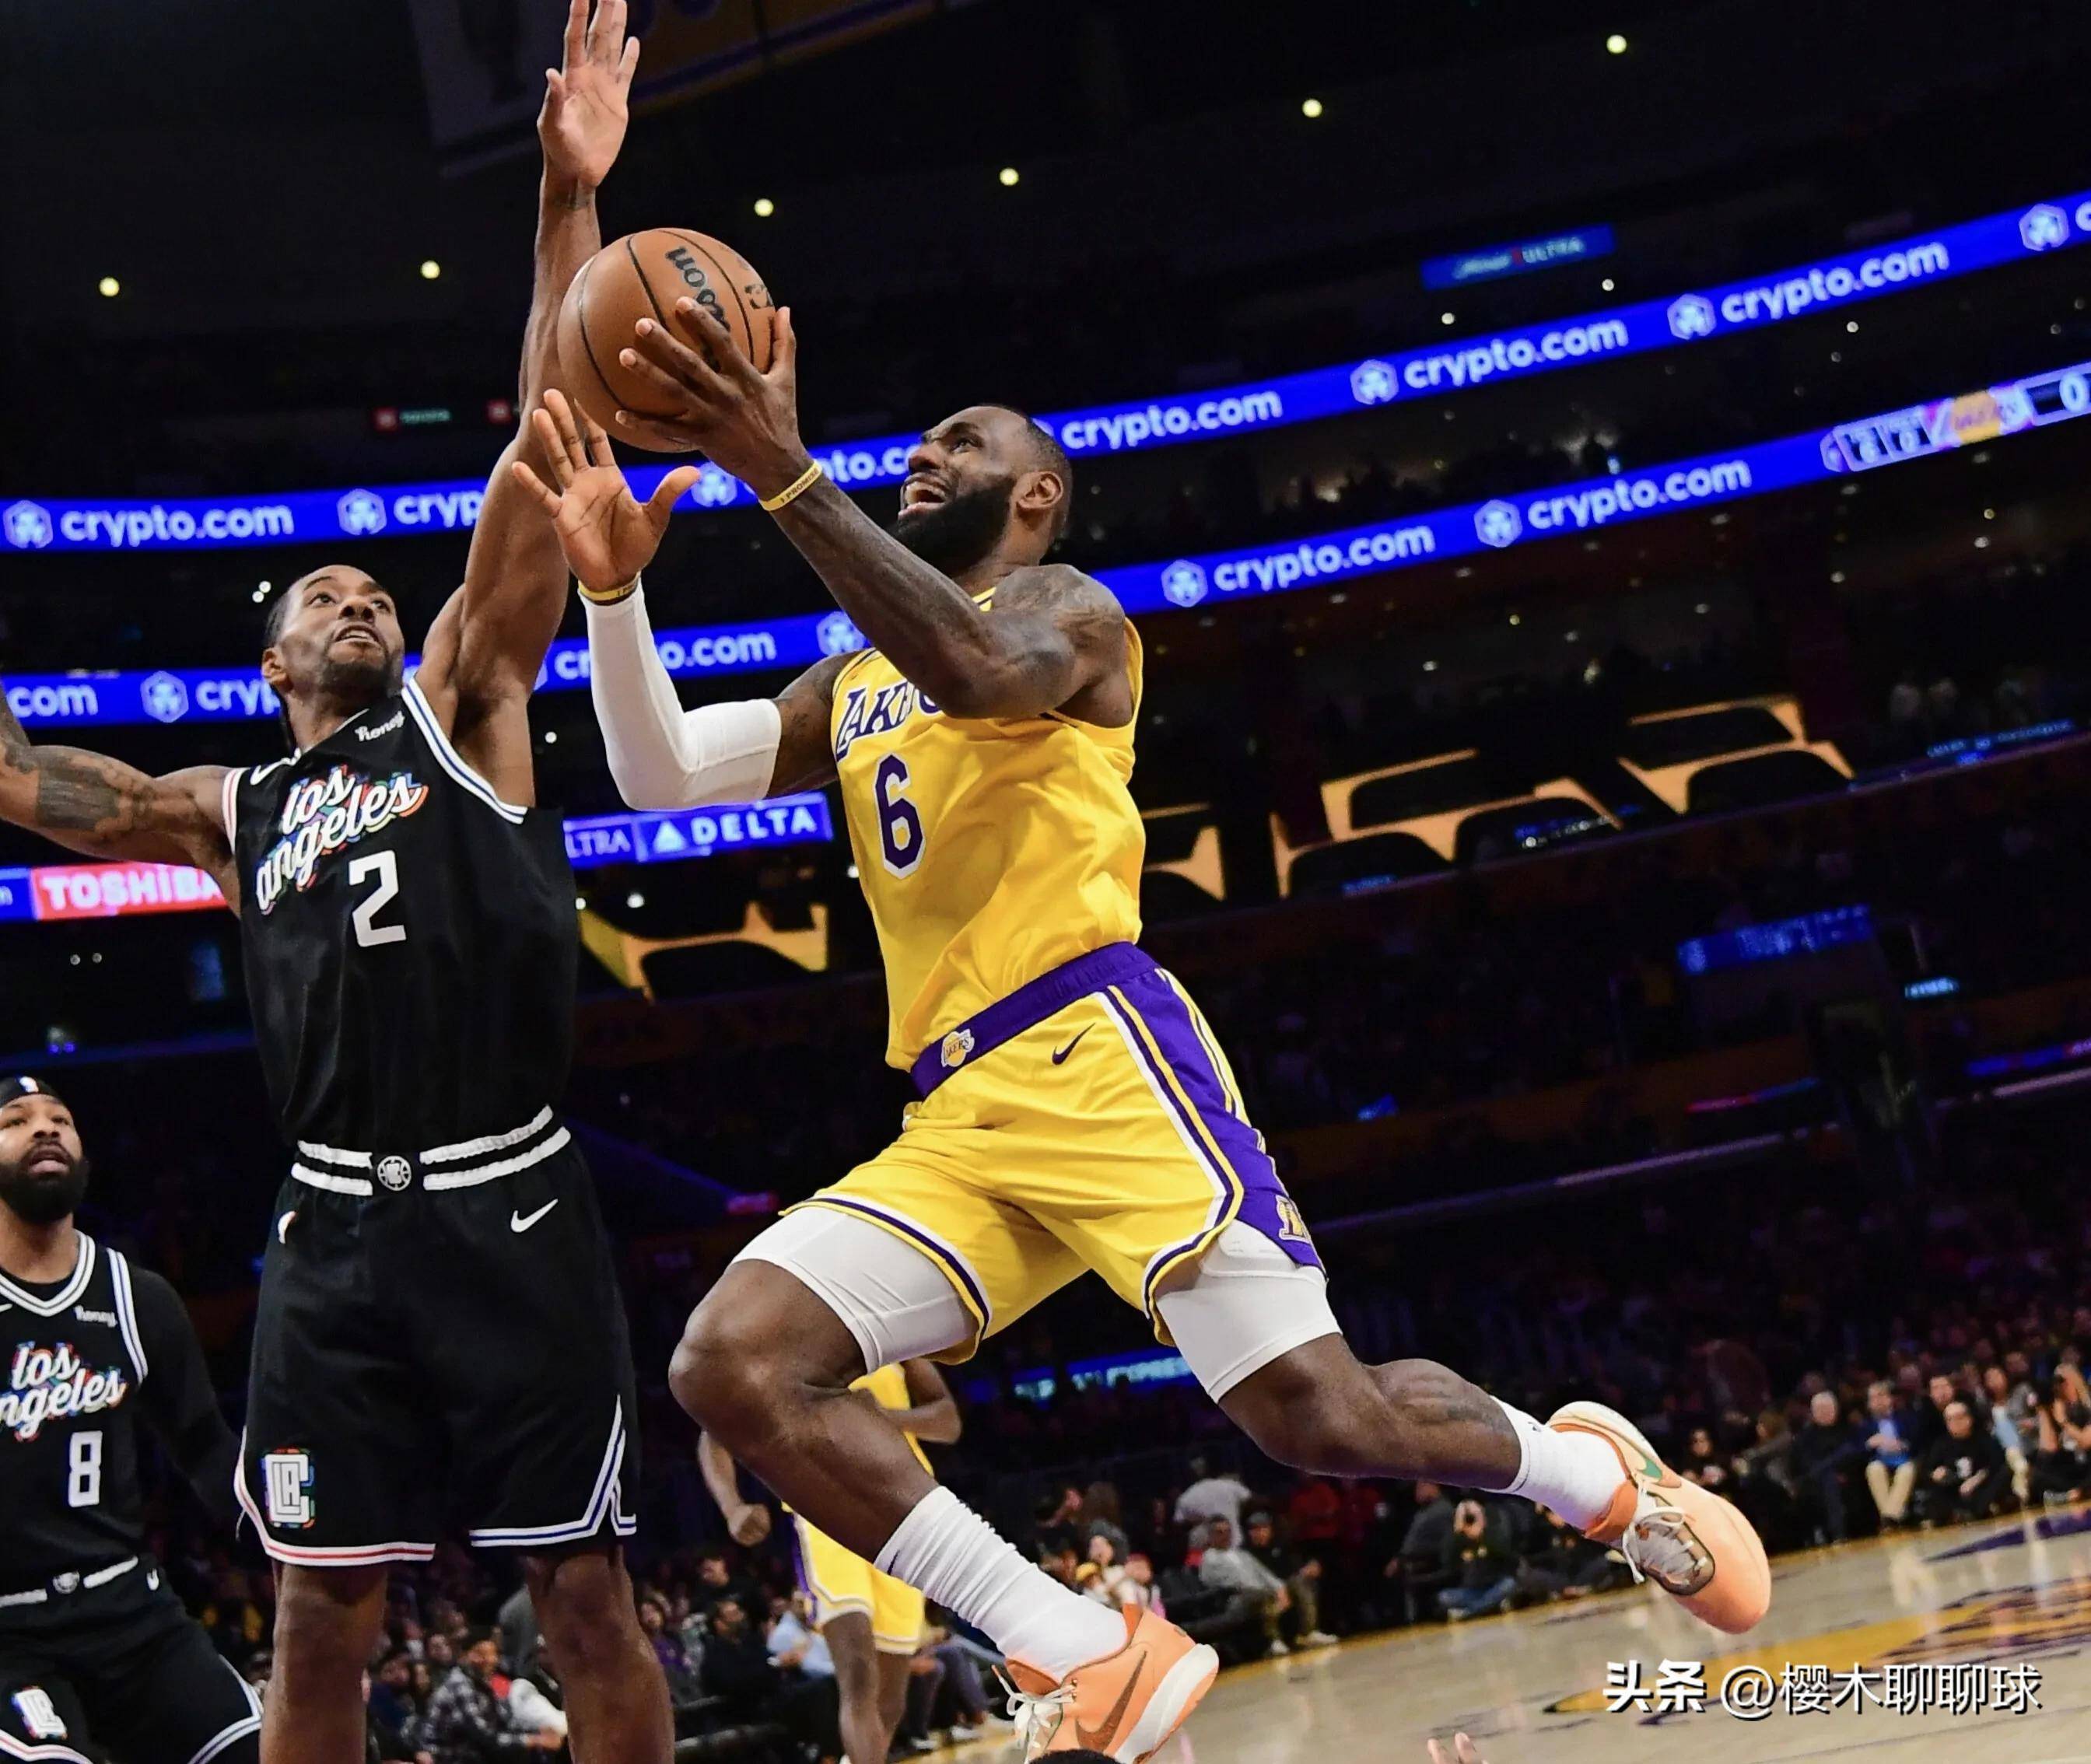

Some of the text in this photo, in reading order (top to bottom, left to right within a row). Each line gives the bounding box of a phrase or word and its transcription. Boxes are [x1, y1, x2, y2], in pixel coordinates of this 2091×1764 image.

[1721, 242, 1950, 320] crypto.com
[1403, 318, 1628, 388] crypto.com
[1060, 390, 1283, 450] crypto.com
[60, 505, 294, 548] crypto.com
[1526, 457, 1751, 527] crypto.com
[1214, 523, 1435, 592] crypto.com
[280, 765, 357, 836] los
[565, 806, 818, 859] LTRA DELTA
[873, 752, 927, 880] 6
[255, 772, 424, 913] angeles
[348, 849, 408, 948] 2
[11, 1345, 81, 1391] los
[0, 1367, 126, 1440] ngeles
[67, 1430, 103, 1508] 8
